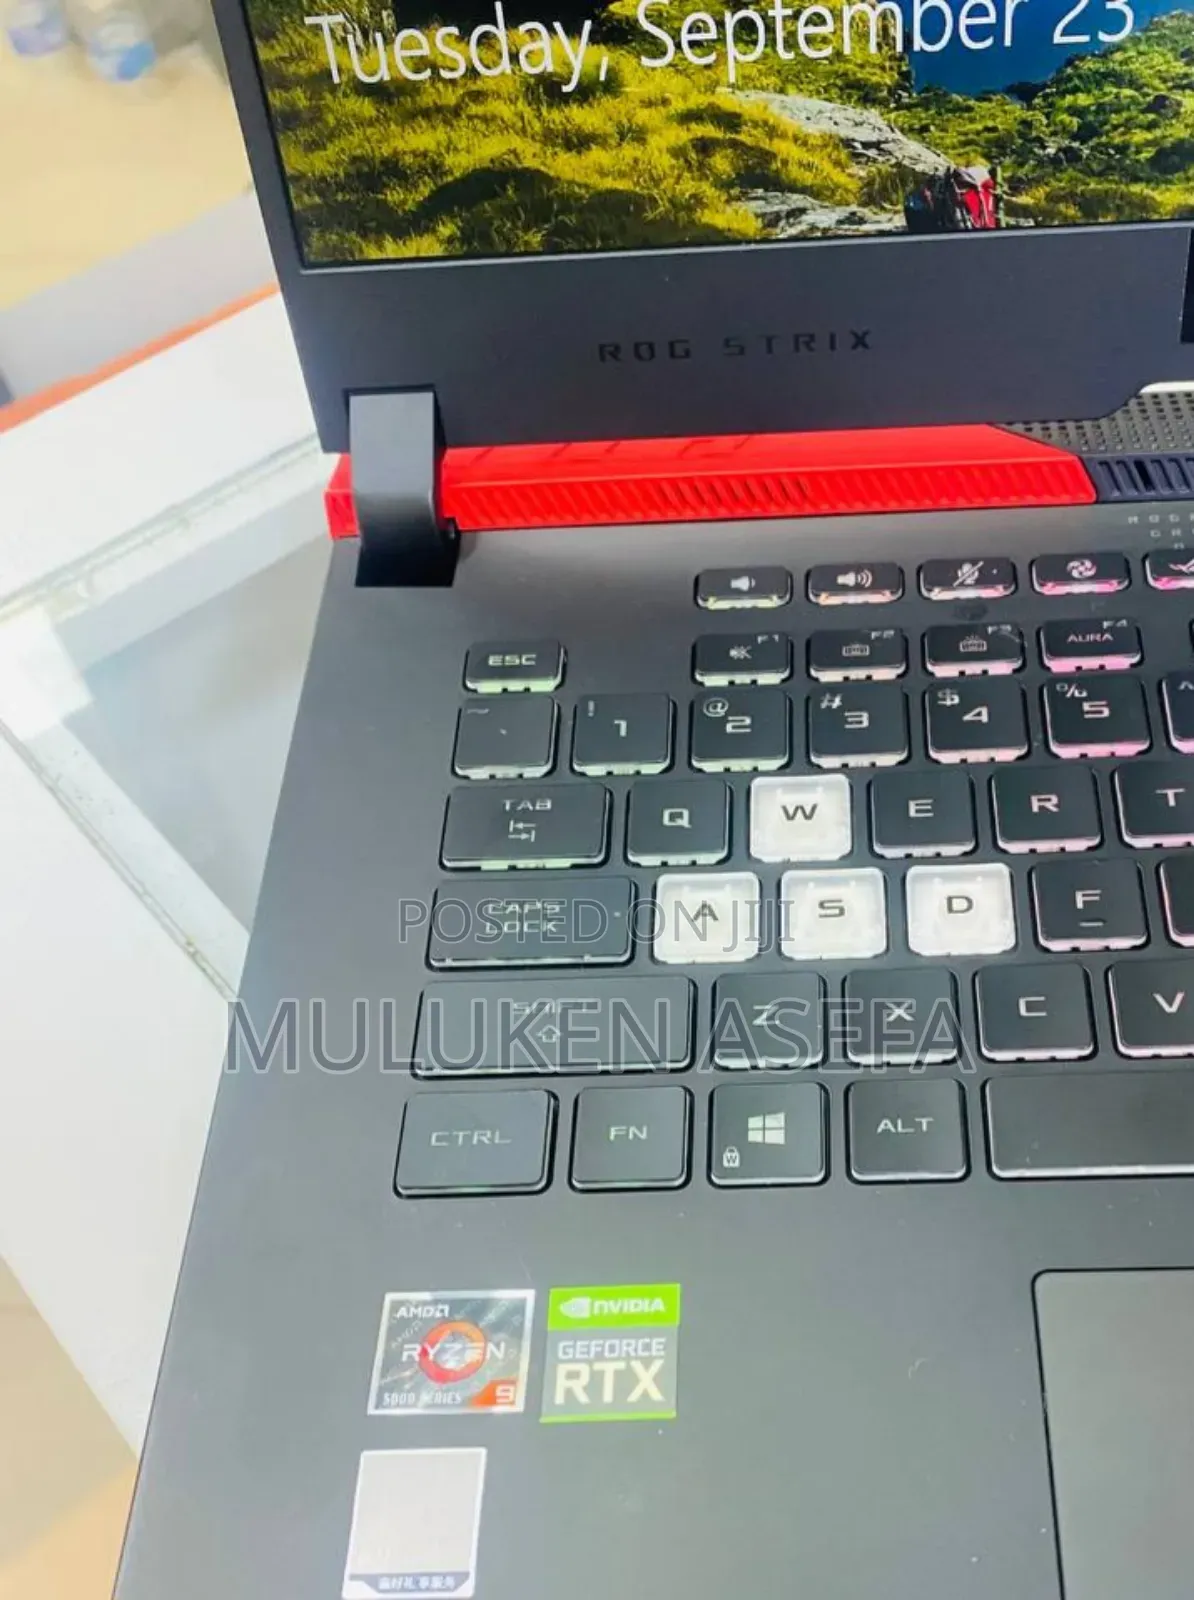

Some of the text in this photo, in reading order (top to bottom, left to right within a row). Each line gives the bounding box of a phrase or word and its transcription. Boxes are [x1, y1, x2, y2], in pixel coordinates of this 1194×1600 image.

[304, 0, 1135, 93] Tuesday, September 23
[597, 330, 872, 363] ROG STRIX
[1102, 618, 1128, 631] F4
[1066, 632, 1114, 645] AURA
[487, 653, 538, 667] ESC
[936, 688, 960, 707] $
[1055, 682, 1089, 699] %
[702, 697, 730, 718] @
[961, 705, 990, 724] 4
[1081, 700, 1111, 719] 5
[725, 715, 752, 734] 2
[843, 710, 870, 729] 3
[502, 798, 553, 812] TAB
[1029, 793, 1060, 814] R
[1155, 787, 1186, 808] T
[781, 802, 819, 822] W
[907, 798, 934, 818] E
[661, 807, 692, 830] Q
[817, 899, 847, 919] S
[945, 895, 975, 915] D
[1074, 889, 1102, 910] F
[691, 903, 719, 923] A
[485, 921, 557, 934] LOCK
[885, 1001, 915, 1022] X
[1017, 995, 1048, 1018] C
[1152, 991, 1185, 1014] V
[752, 1003, 781, 1027] Z
[608, 1125, 648, 1142] FN
[876, 1116, 935, 1135] ALT
[429, 1128, 512, 1147] CTRL
[396, 1304, 440, 1319] AMD
[402, 1341, 506, 1363] RYZEN
[556, 1337, 667, 1360] GEFORCE
[554, 1359, 667, 1406] RTX
[494, 1383, 515, 1404] 9
